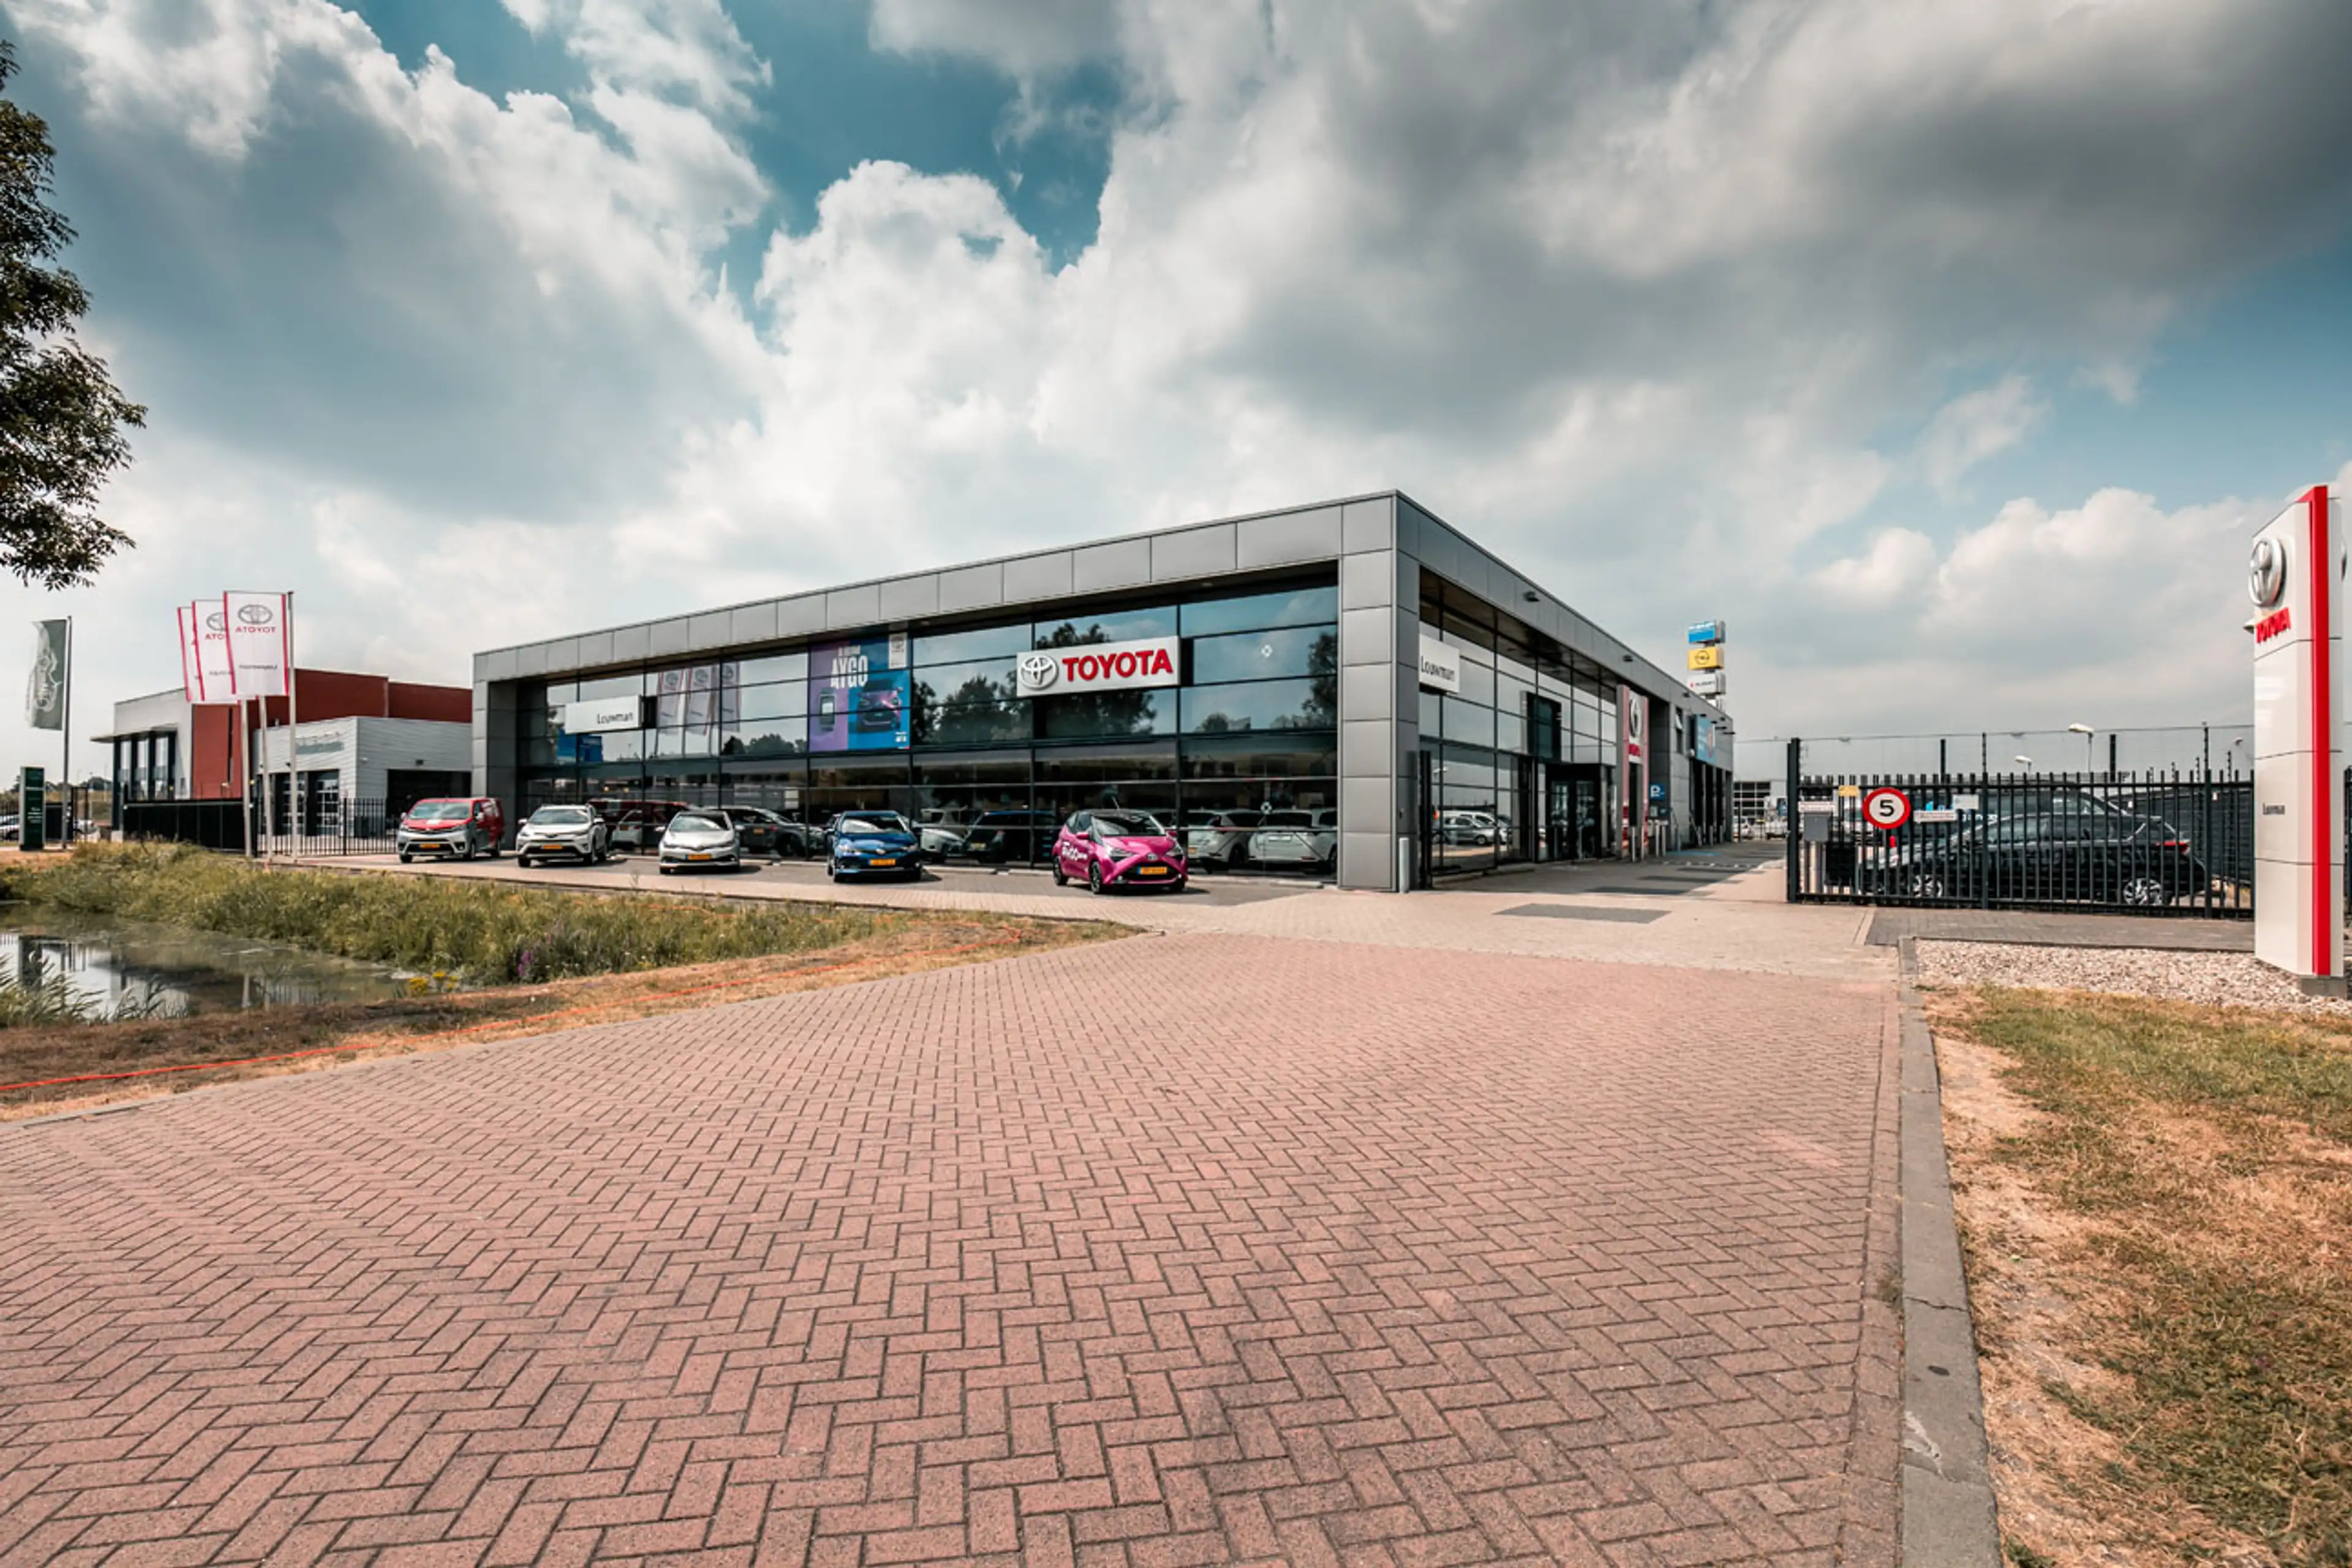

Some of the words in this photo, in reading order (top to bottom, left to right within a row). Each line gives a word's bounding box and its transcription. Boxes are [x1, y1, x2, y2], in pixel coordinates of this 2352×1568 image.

[831, 655, 869, 690] AYGO
[1062, 649, 1173, 682] TOYOTA
[1880, 799, 1895, 817] 5
